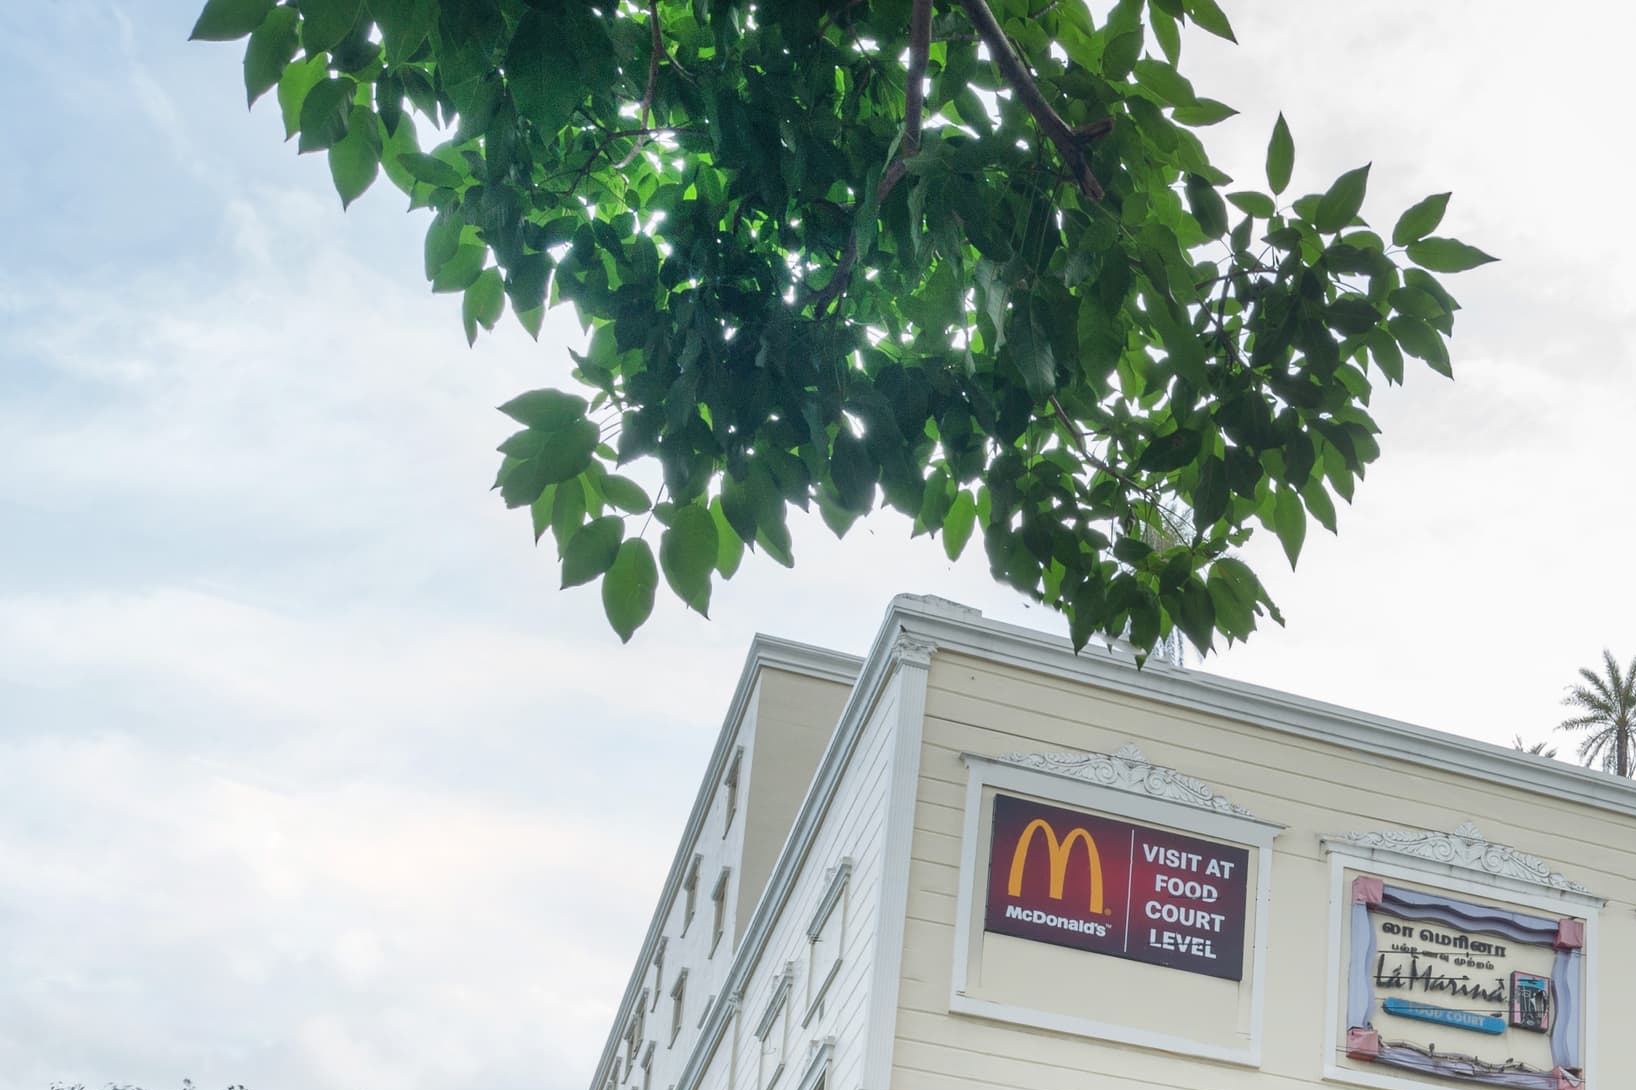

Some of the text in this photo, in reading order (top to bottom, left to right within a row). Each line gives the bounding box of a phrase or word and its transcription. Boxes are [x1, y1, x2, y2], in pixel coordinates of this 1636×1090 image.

[1143, 843, 1234, 880] VISIT AT
[1154, 873, 1218, 903] FOOD
[1005, 904, 1108, 938] McDonald's
[1145, 900, 1225, 933] COURT
[1149, 928, 1217, 960] LEVEL
